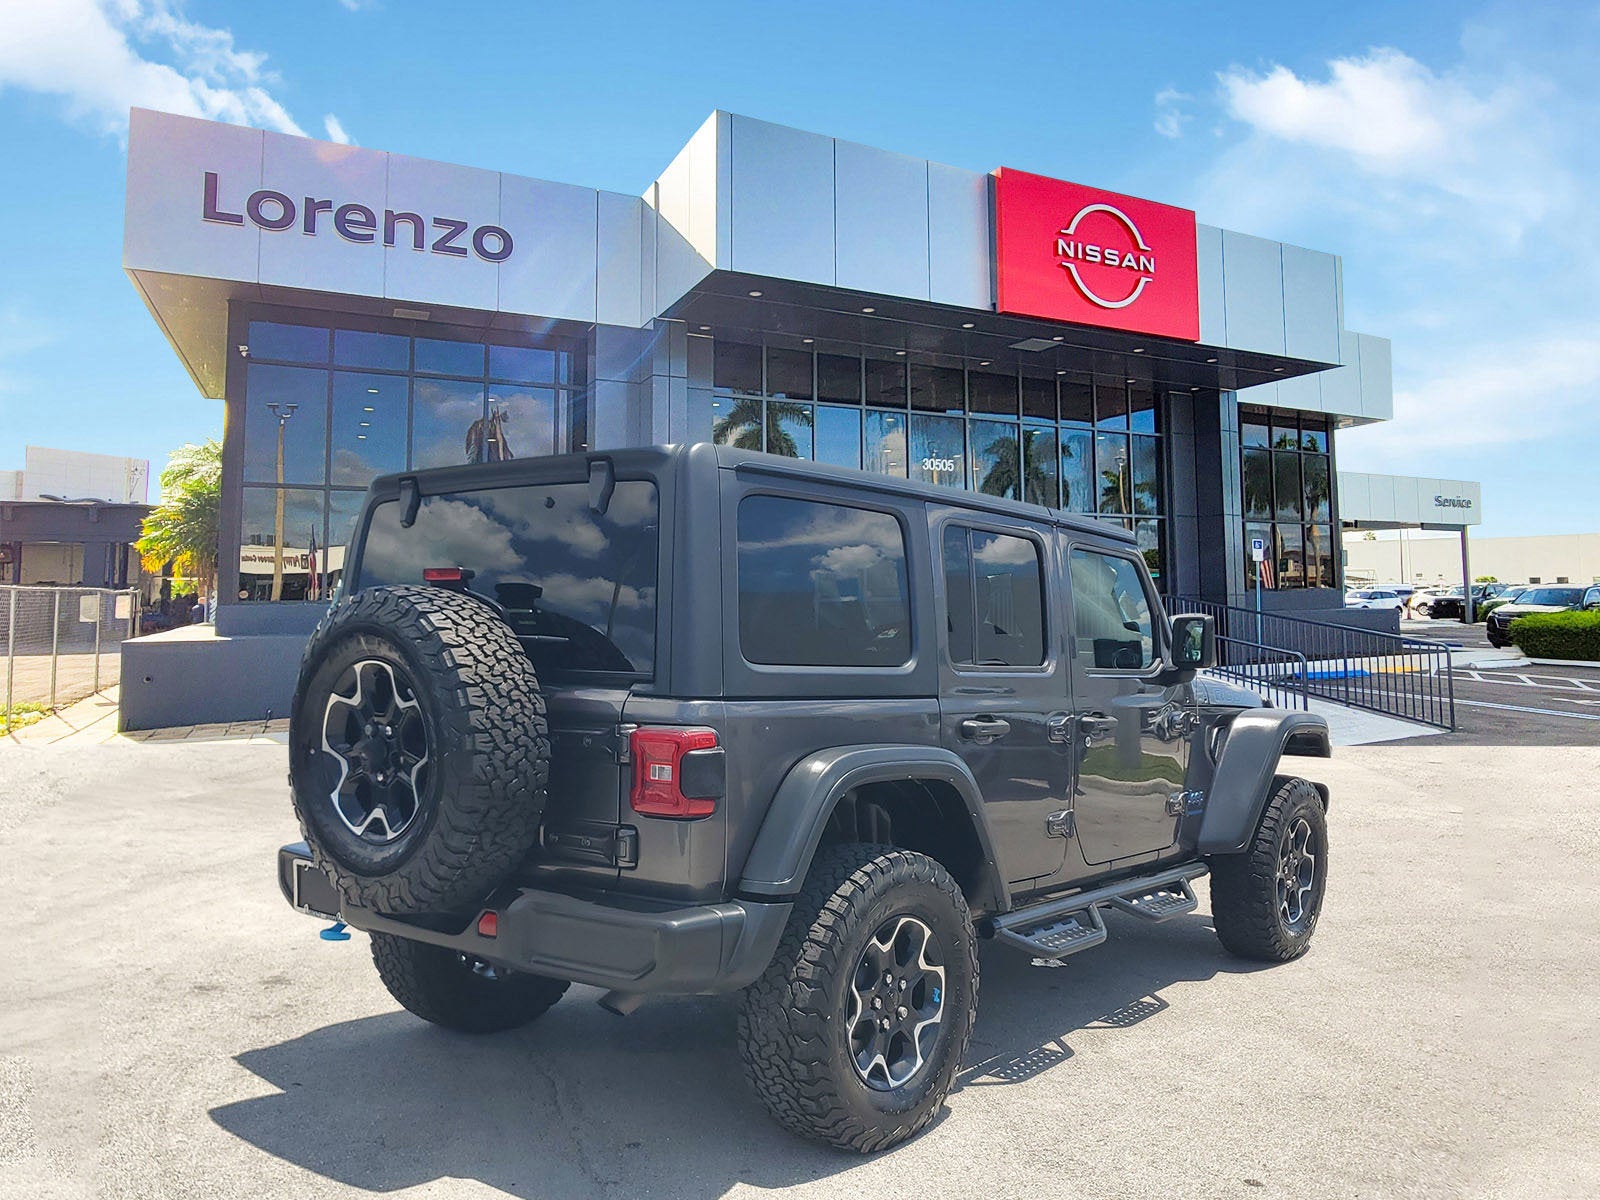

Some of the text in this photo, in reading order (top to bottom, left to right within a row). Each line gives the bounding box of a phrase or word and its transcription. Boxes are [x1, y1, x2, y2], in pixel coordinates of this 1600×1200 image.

[203, 171, 514, 262] Lorenzo
[1057, 238, 1155, 273] NISSAN
[922, 457, 955, 472] 30505
[1434, 495, 1472, 509] Service
